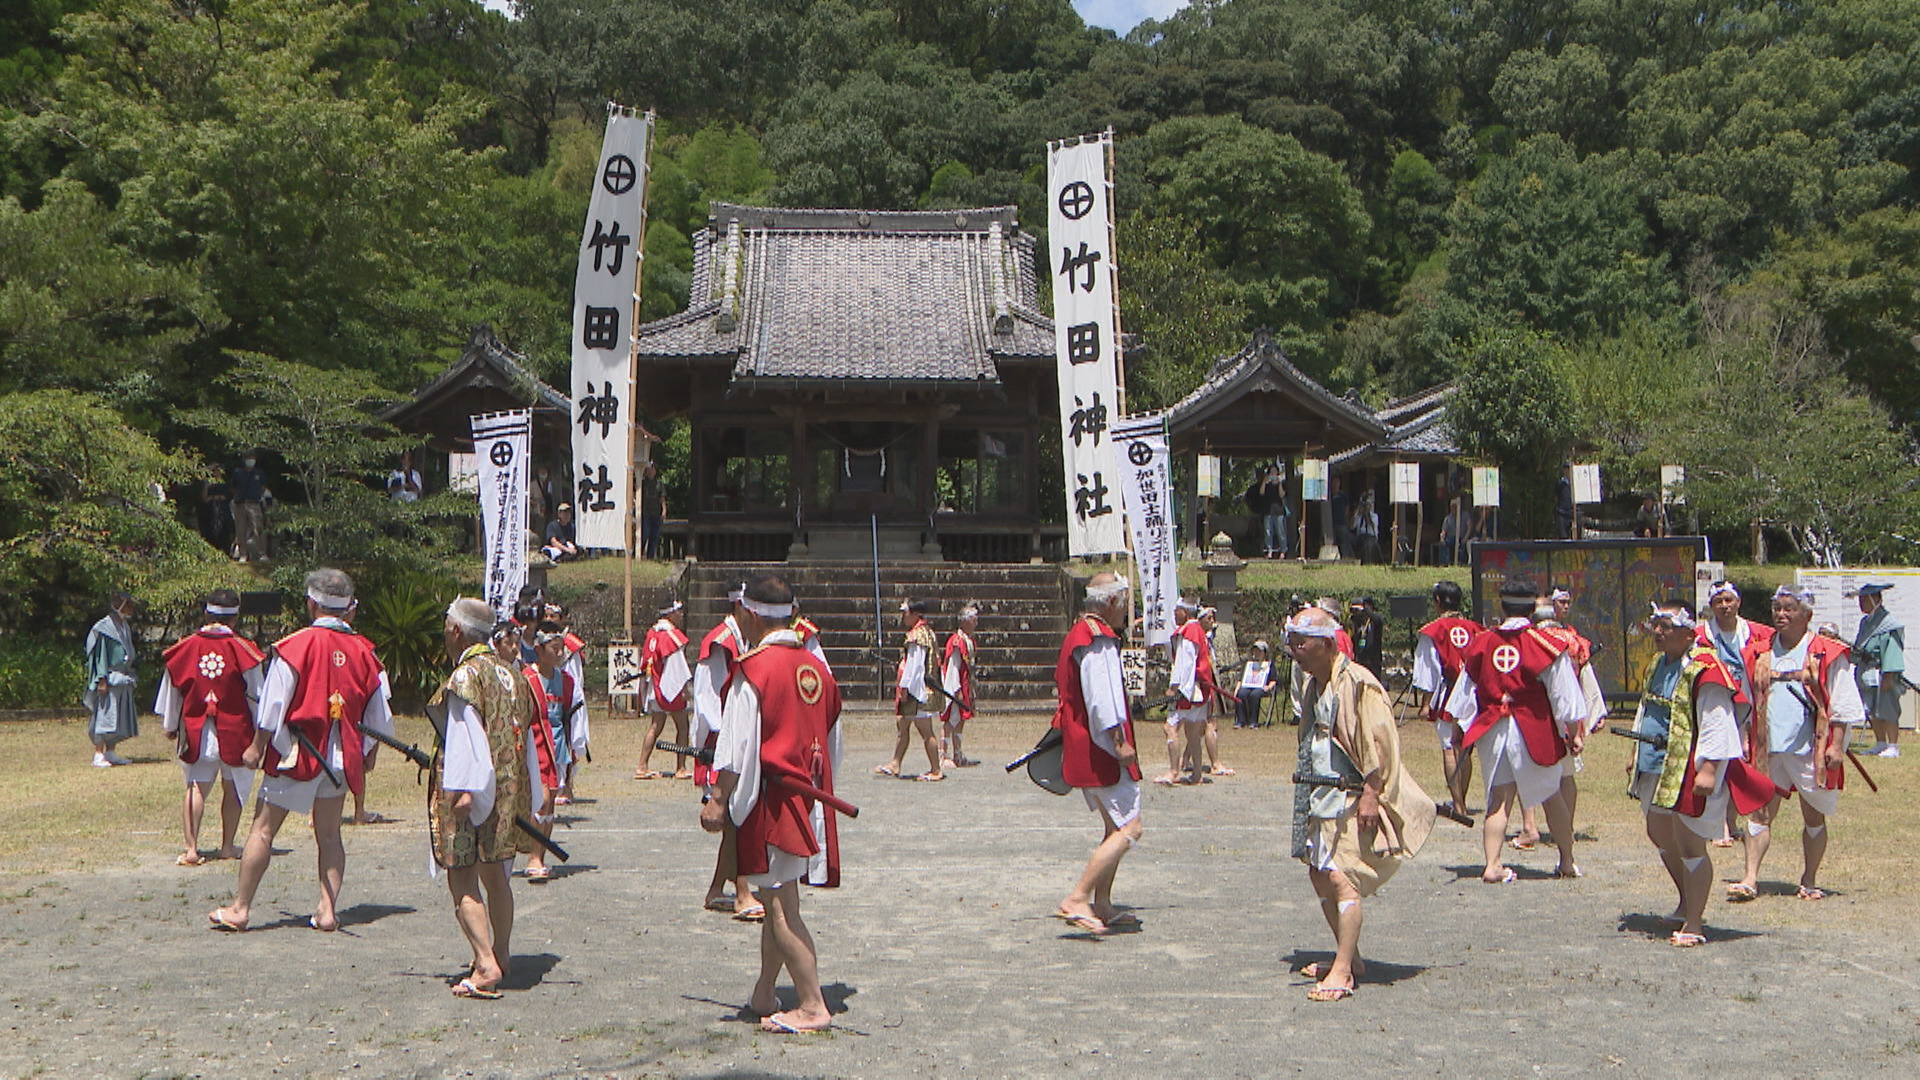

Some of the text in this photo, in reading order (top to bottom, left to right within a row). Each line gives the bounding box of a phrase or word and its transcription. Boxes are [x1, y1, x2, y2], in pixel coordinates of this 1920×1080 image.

[577, 219, 630, 513] 竹田神社
[1058, 241, 1112, 520] 竹田神社
